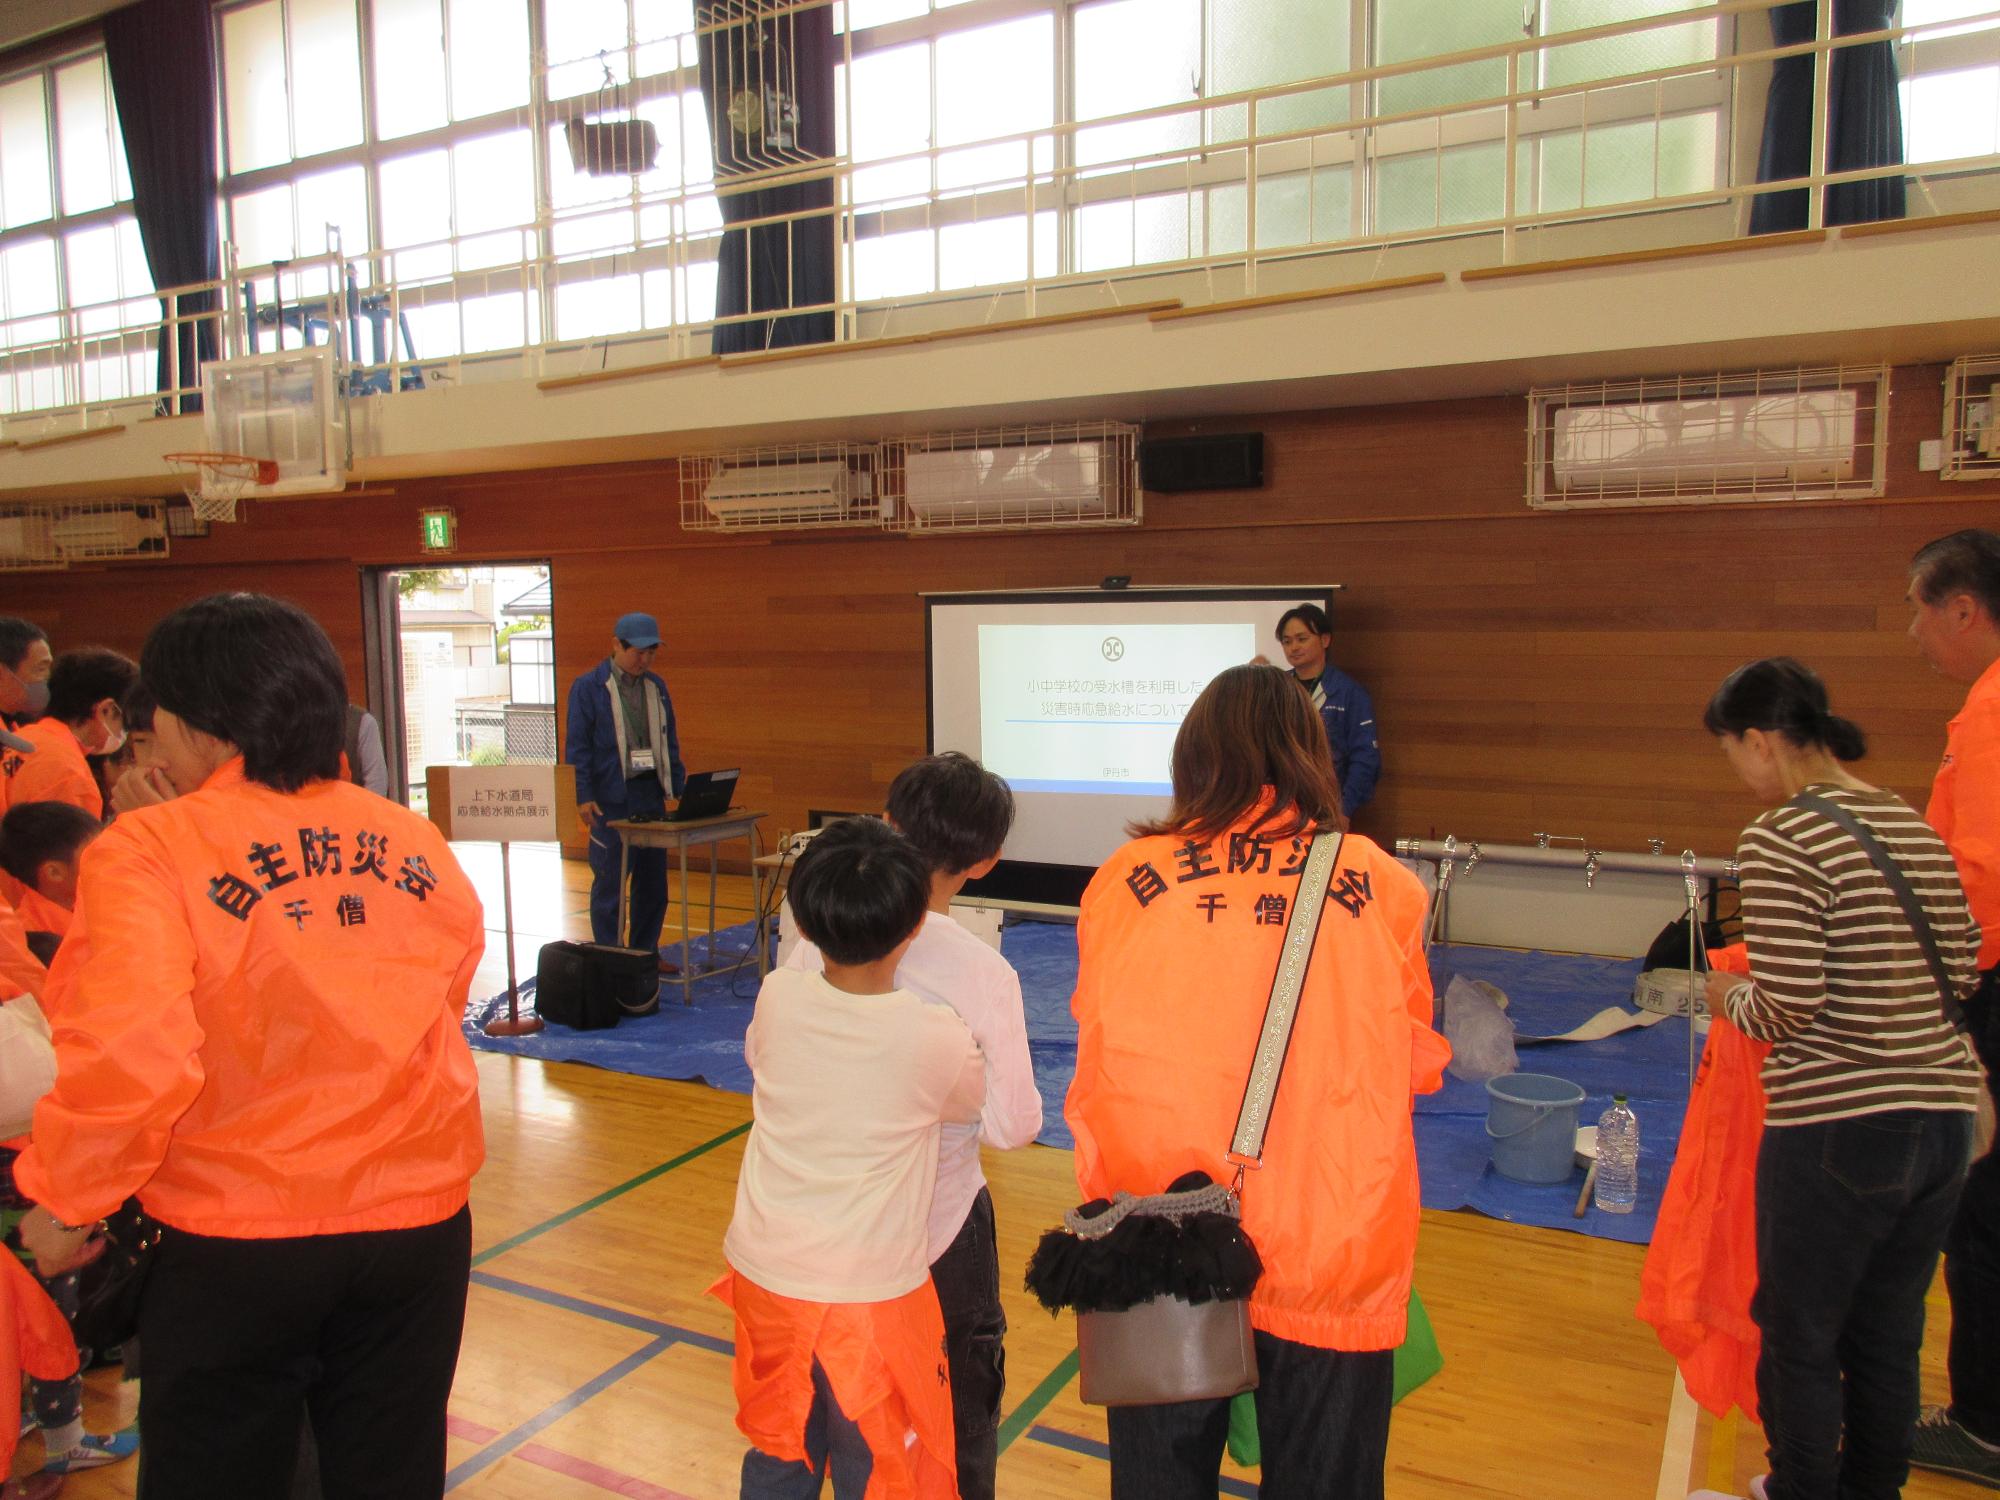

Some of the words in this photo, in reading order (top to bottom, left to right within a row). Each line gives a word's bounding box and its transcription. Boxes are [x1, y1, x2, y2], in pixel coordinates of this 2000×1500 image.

[1027, 679, 1203, 695] 小中学校の受水槽を利用した
[1041, 702, 1190, 717] 災害時応急給水について
[1102, 767, 1130, 778] 伊丹市
[472, 788, 534, 802] 上下水道局
[457, 805, 549, 817] 応急給水拠点展示
[207, 826, 438, 922] 自主防災会
[283, 894, 367, 931] 千僧
[1196, 893, 1288, 926] 千僧
